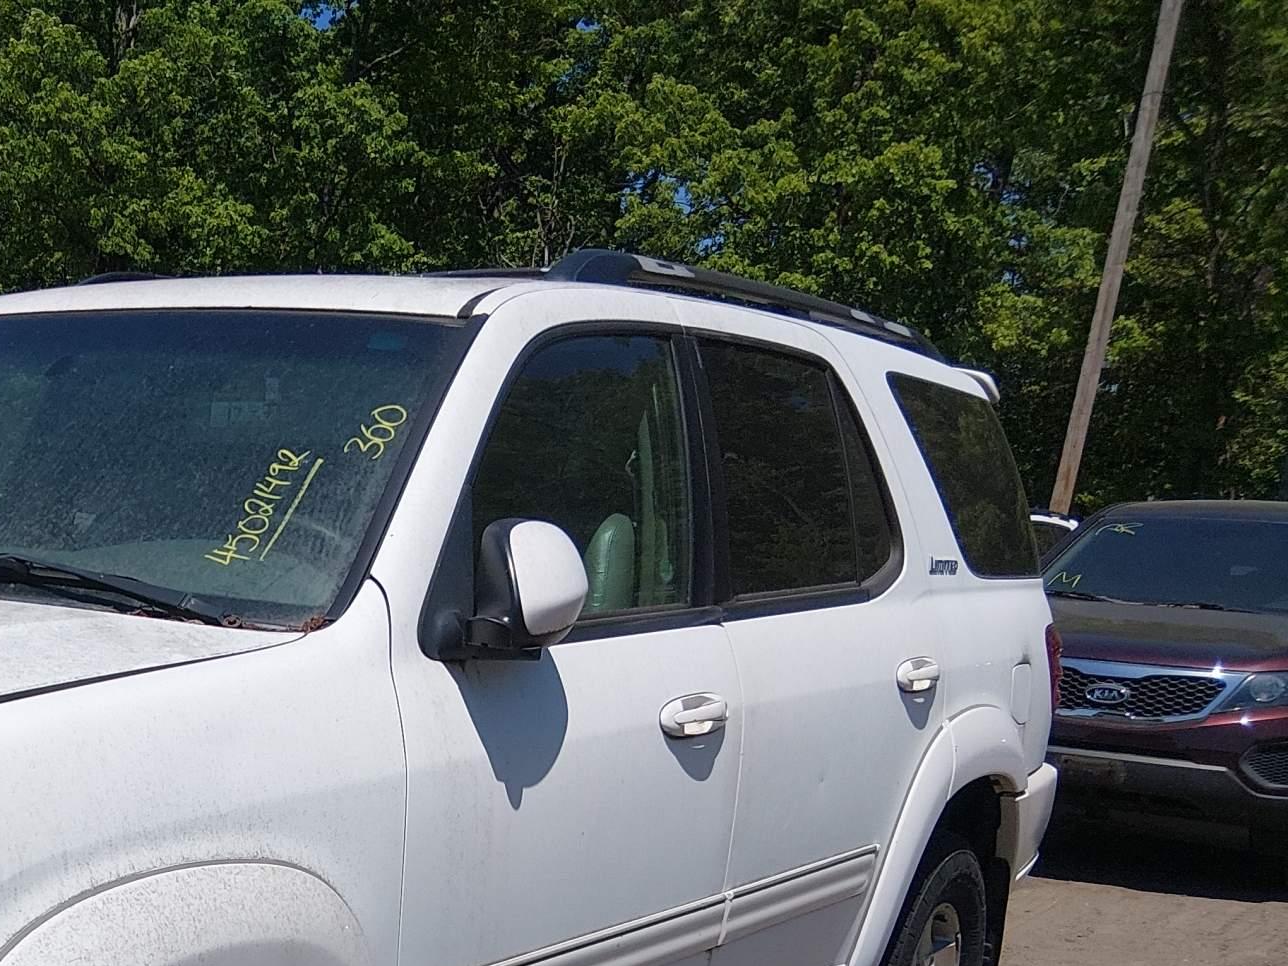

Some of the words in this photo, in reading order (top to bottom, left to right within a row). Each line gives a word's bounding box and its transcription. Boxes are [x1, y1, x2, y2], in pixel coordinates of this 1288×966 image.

[342, 404, 408, 460] 360
[203, 448, 312, 566] 45021492
[1047, 571, 1083, 589] M
[1092, 688, 1121, 700] KIA
